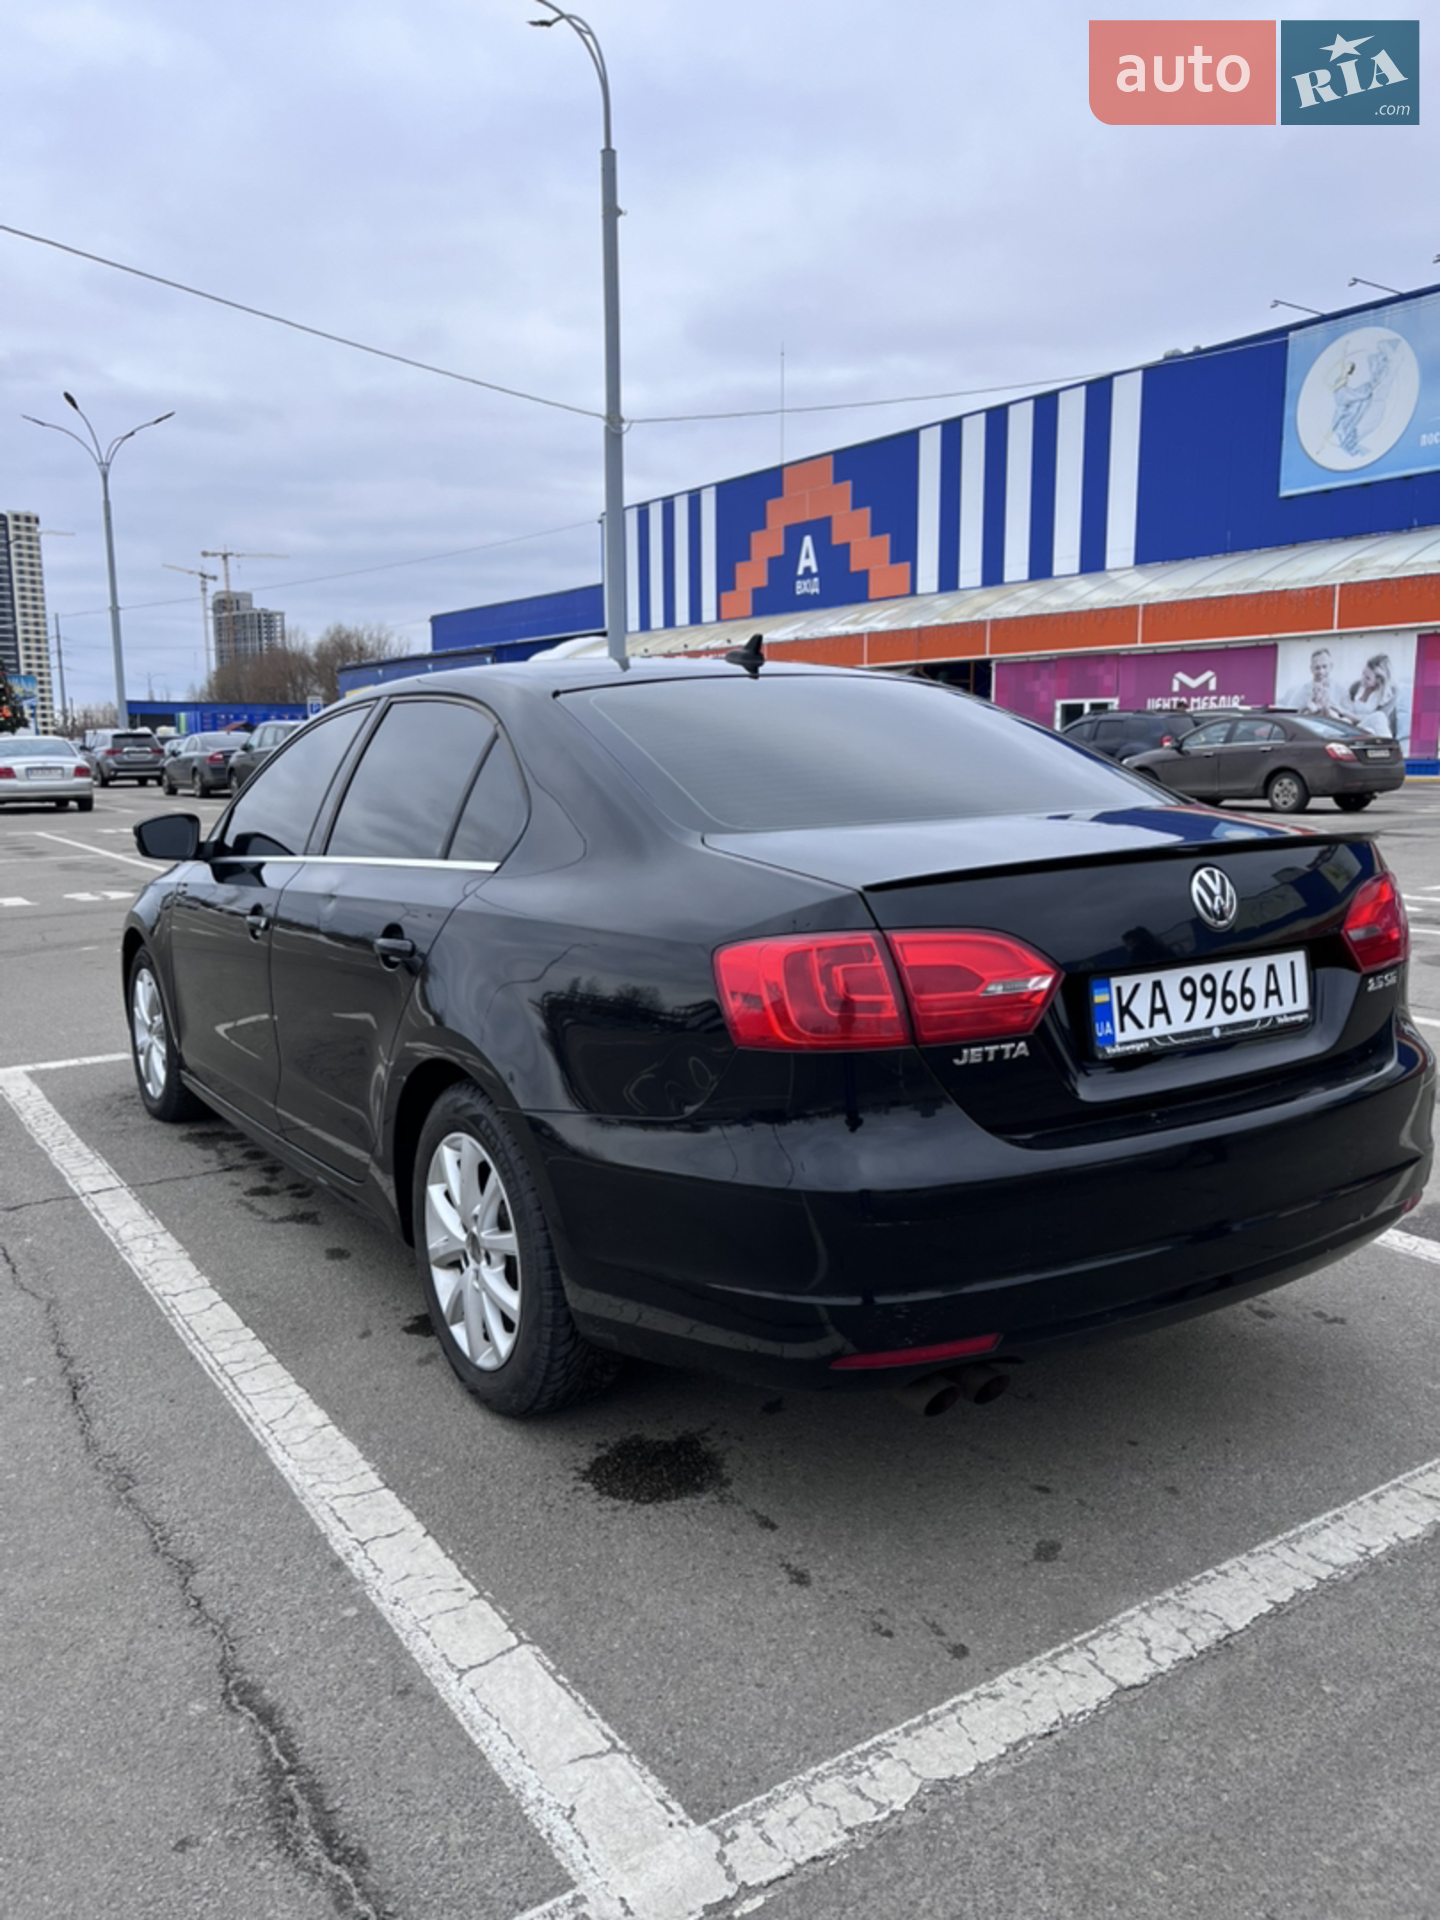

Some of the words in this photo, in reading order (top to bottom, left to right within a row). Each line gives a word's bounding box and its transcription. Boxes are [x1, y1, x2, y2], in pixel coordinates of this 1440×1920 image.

[796, 534, 819, 576] А
[1116, 980, 1173, 1034] KA
[1178, 973, 1256, 1024] 9966
[1264, 960, 1299, 1011] AI
[1095, 1021, 1113, 1037] UA
[953, 1041, 1030, 1066] JETTA
